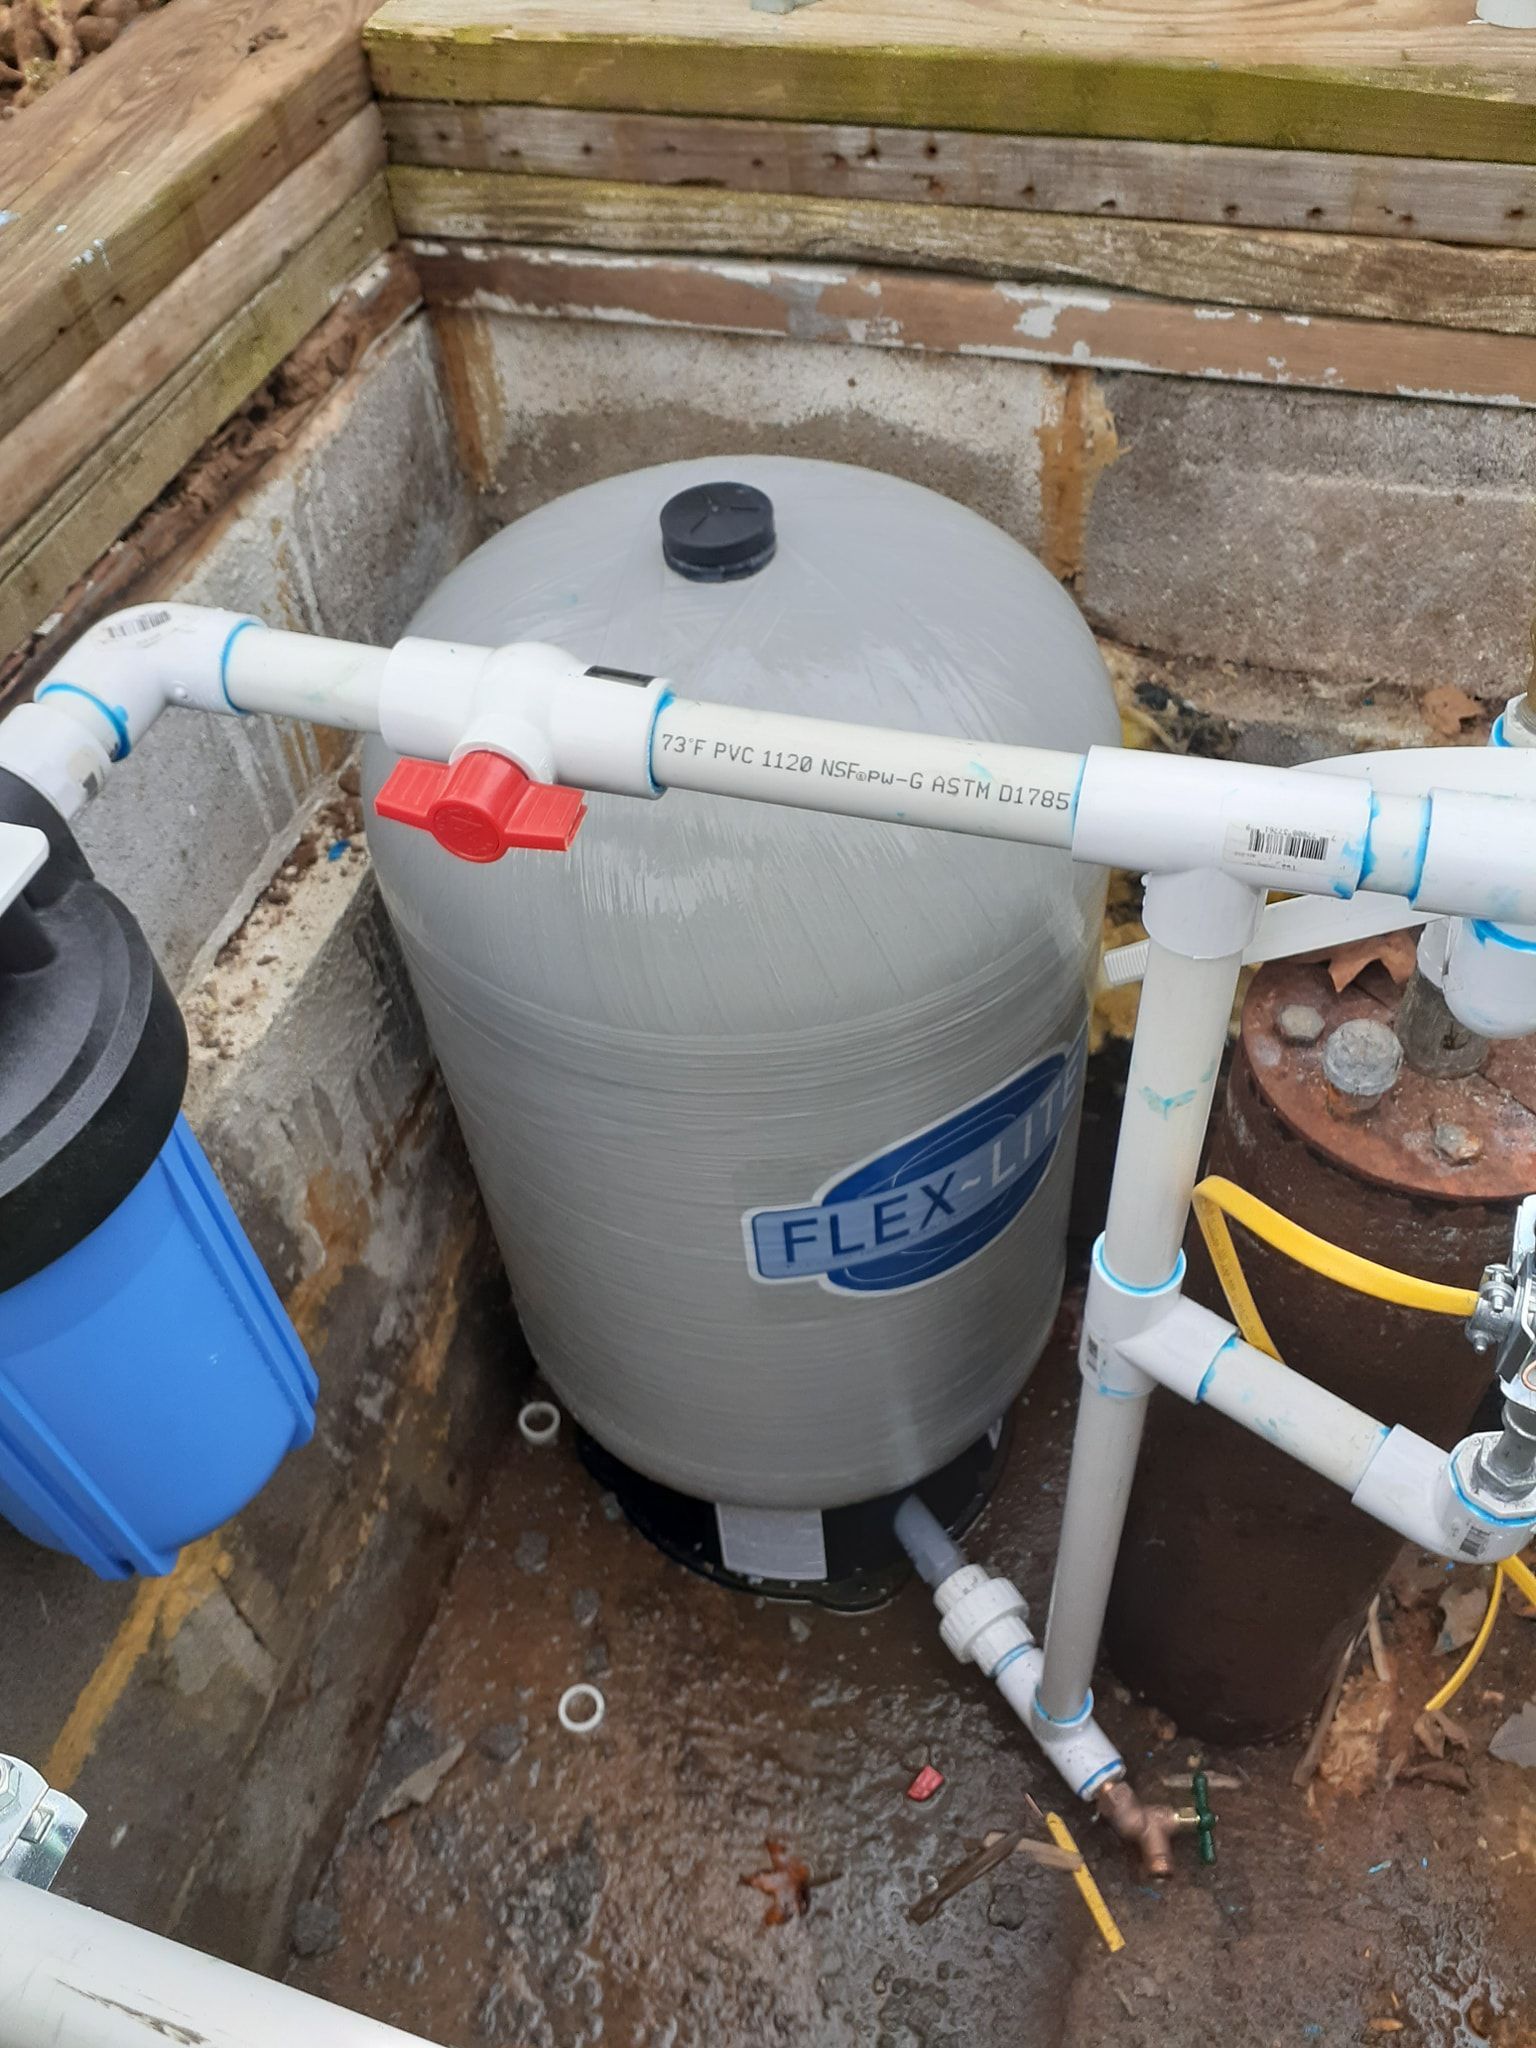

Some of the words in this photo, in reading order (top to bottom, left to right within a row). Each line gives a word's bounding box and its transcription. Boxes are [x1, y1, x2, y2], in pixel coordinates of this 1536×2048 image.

[661, 733, 707, 756] 73°F
[713, 741, 755, 764] PVC
[761, 750, 813, 773] 1120
[931, 775, 991, 800] ASTM
[998, 784, 1072, 811] D1785
[782, 1058, 1079, 1263] FLEX-LITE
